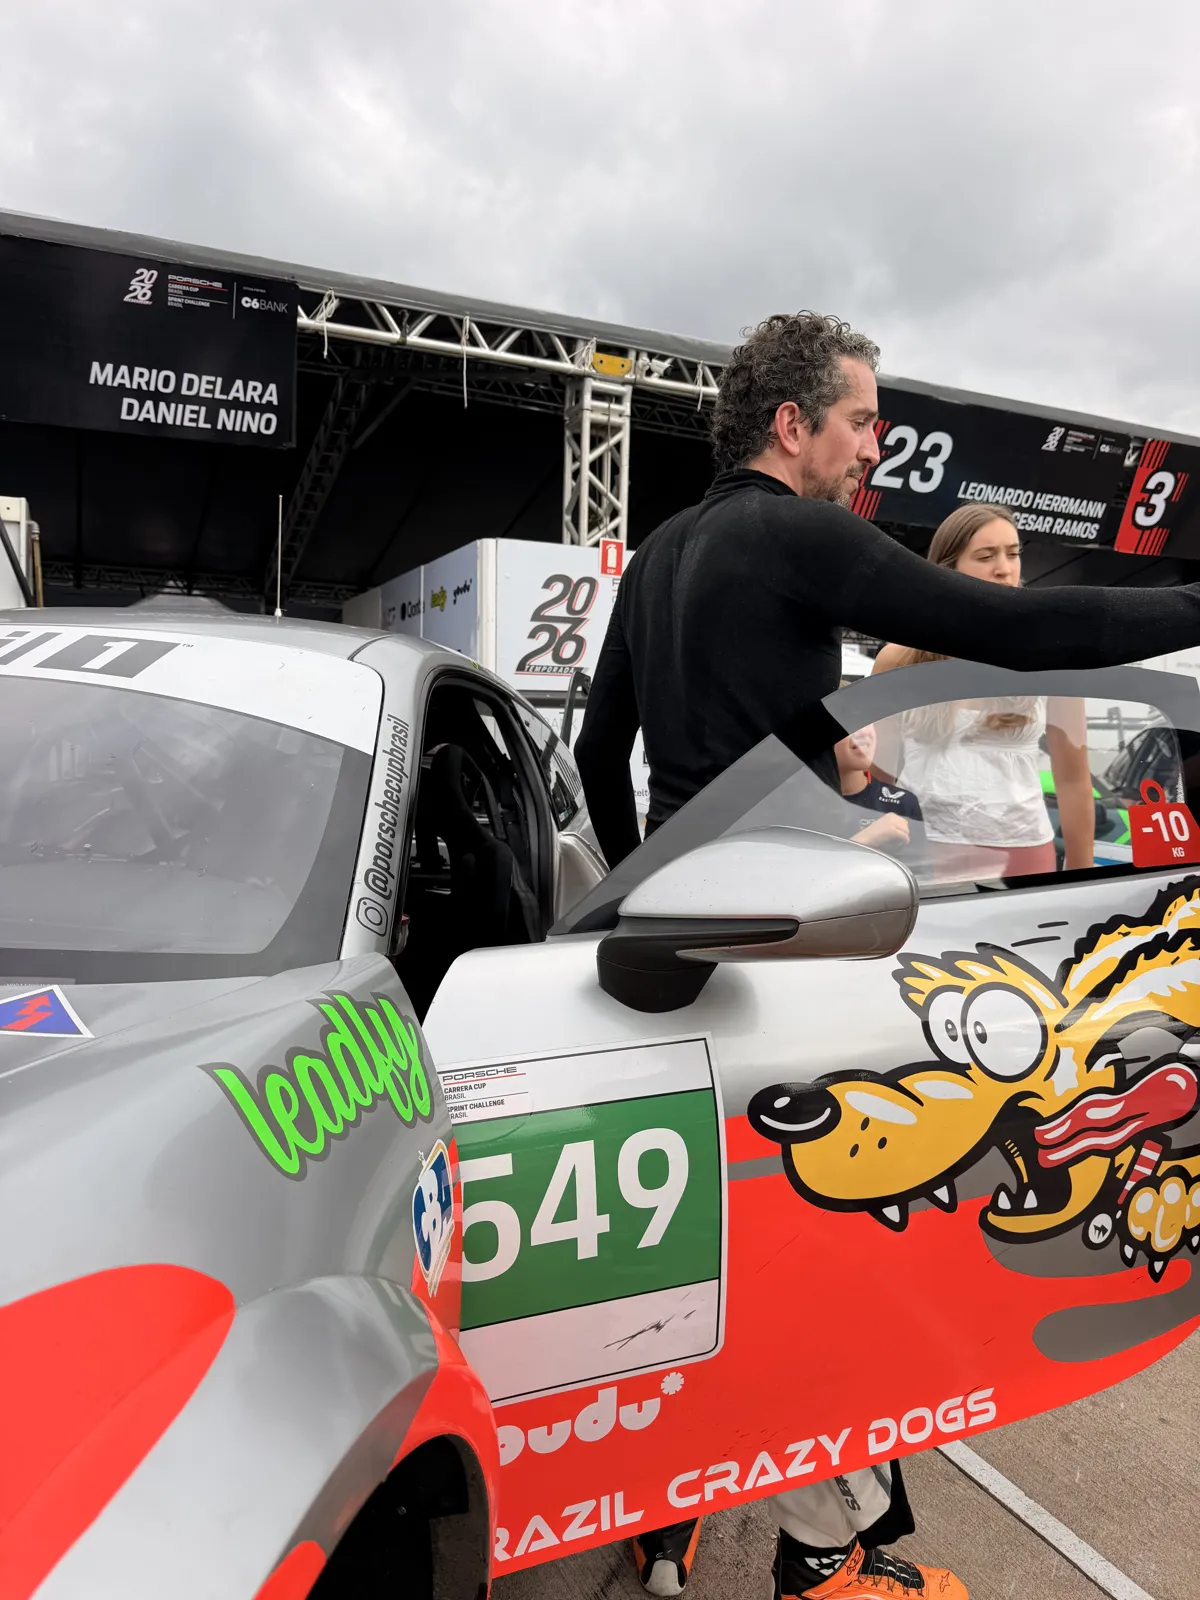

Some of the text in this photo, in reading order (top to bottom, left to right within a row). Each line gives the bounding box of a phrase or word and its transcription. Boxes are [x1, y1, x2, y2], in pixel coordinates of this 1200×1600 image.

[130, 268, 158, 284] 20
[168, 275, 222, 288] PORSCHE
[123, 284, 153, 300] 26
[241, 296, 288, 314] C6BANK
[89, 361, 279, 406] MARIO DELARA
[120, 397, 278, 435] DANIEL NINO
[870, 425, 953, 493] 23
[957, 480, 1107, 518] LEONARDO HERRMANN
[1135, 471, 1175, 527] 3
[1012, 511, 1099, 540] CESAR RAMOS
[530, 574, 599, 623] 20
[515, 618, 587, 672] 26
[524, 665, 575, 674] TEMPORADA
[364, 713, 409, 901] @porschecupbrasil
[1142, 810, 1190, 842] -10
[1171, 847, 1185, 857] KG
[442, 1066, 517, 1082] PORSCHE
[444, 1082, 487, 1094] CARRERA CUP
[444, 1093, 466, 1101] BRASIL
[469, 1099, 505, 1110] CHALLENGE
[460, 1127, 689, 1283] 549
[667, 1427, 852, 1508] CRAZY
[868, 1387, 997, 1456] DOGS
